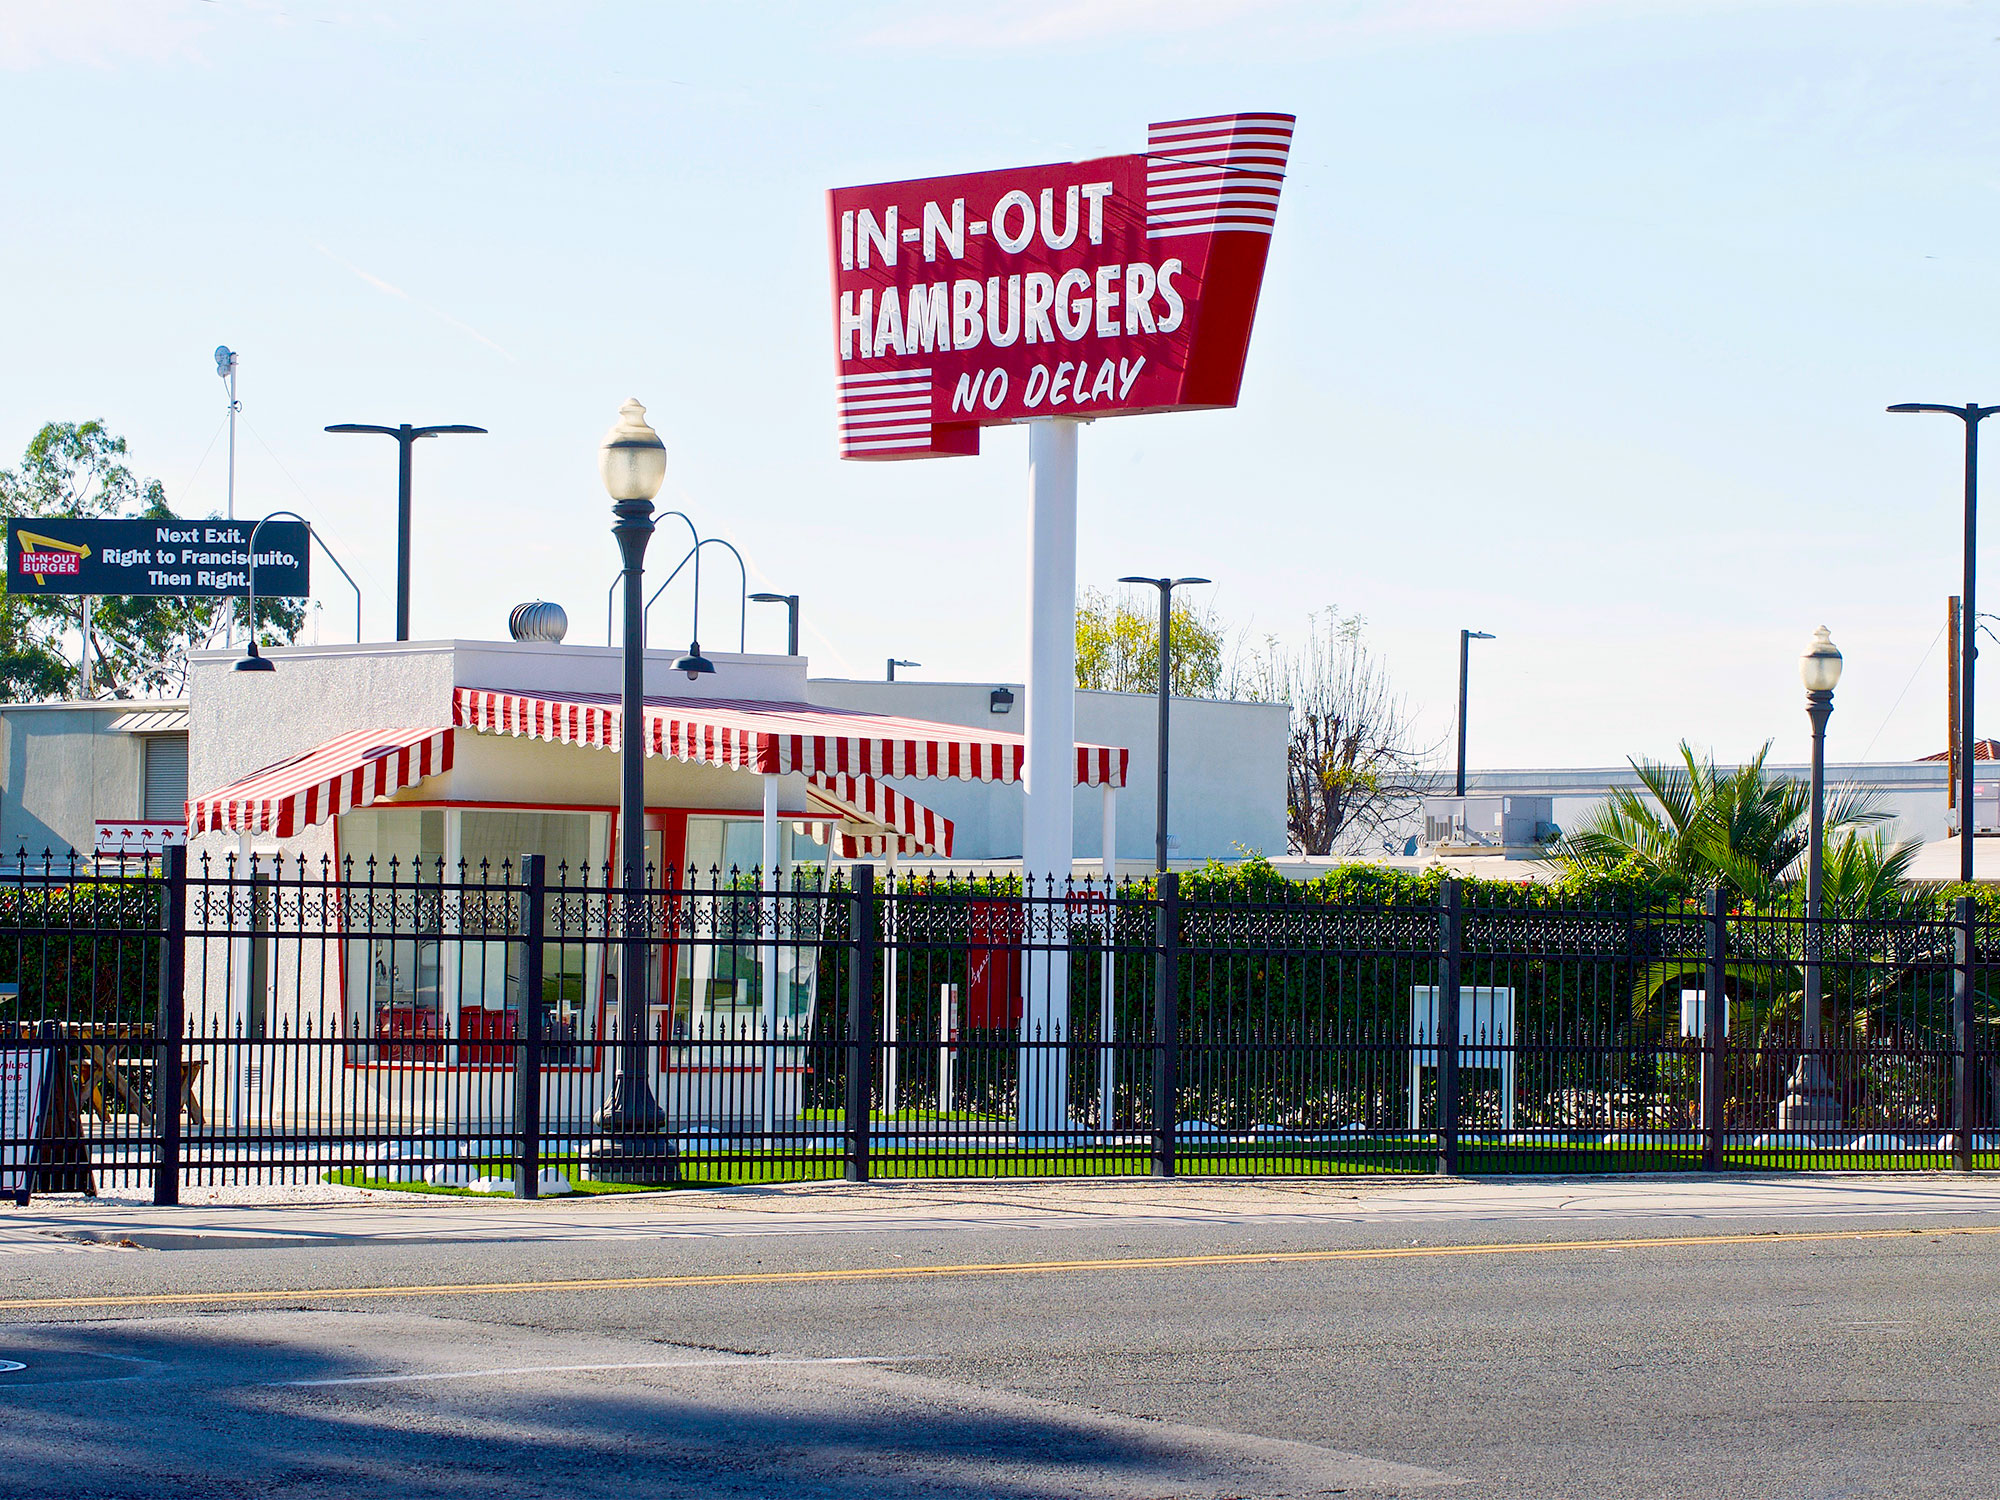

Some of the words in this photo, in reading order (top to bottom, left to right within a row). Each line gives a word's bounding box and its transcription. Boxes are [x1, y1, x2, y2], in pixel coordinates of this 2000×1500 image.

[840, 181, 1114, 271] IN-N-OUT
[839, 258, 1185, 361] HAMBURGERS
[951, 367, 1009, 414] NO
[1023, 355, 1147, 408] DELAY
[156, 528, 200, 543] Next
[205, 528, 246, 543] Exit.
[23, 554, 77, 564] IN-N-OUT
[102, 548, 151, 567] Right
[156, 549, 176, 565] to
[181, 549, 299, 569] Francisquito,
[148, 570, 191, 586] Then
[197, 571, 251, 589] Right.
[1065, 890, 1109, 915] OPEN
